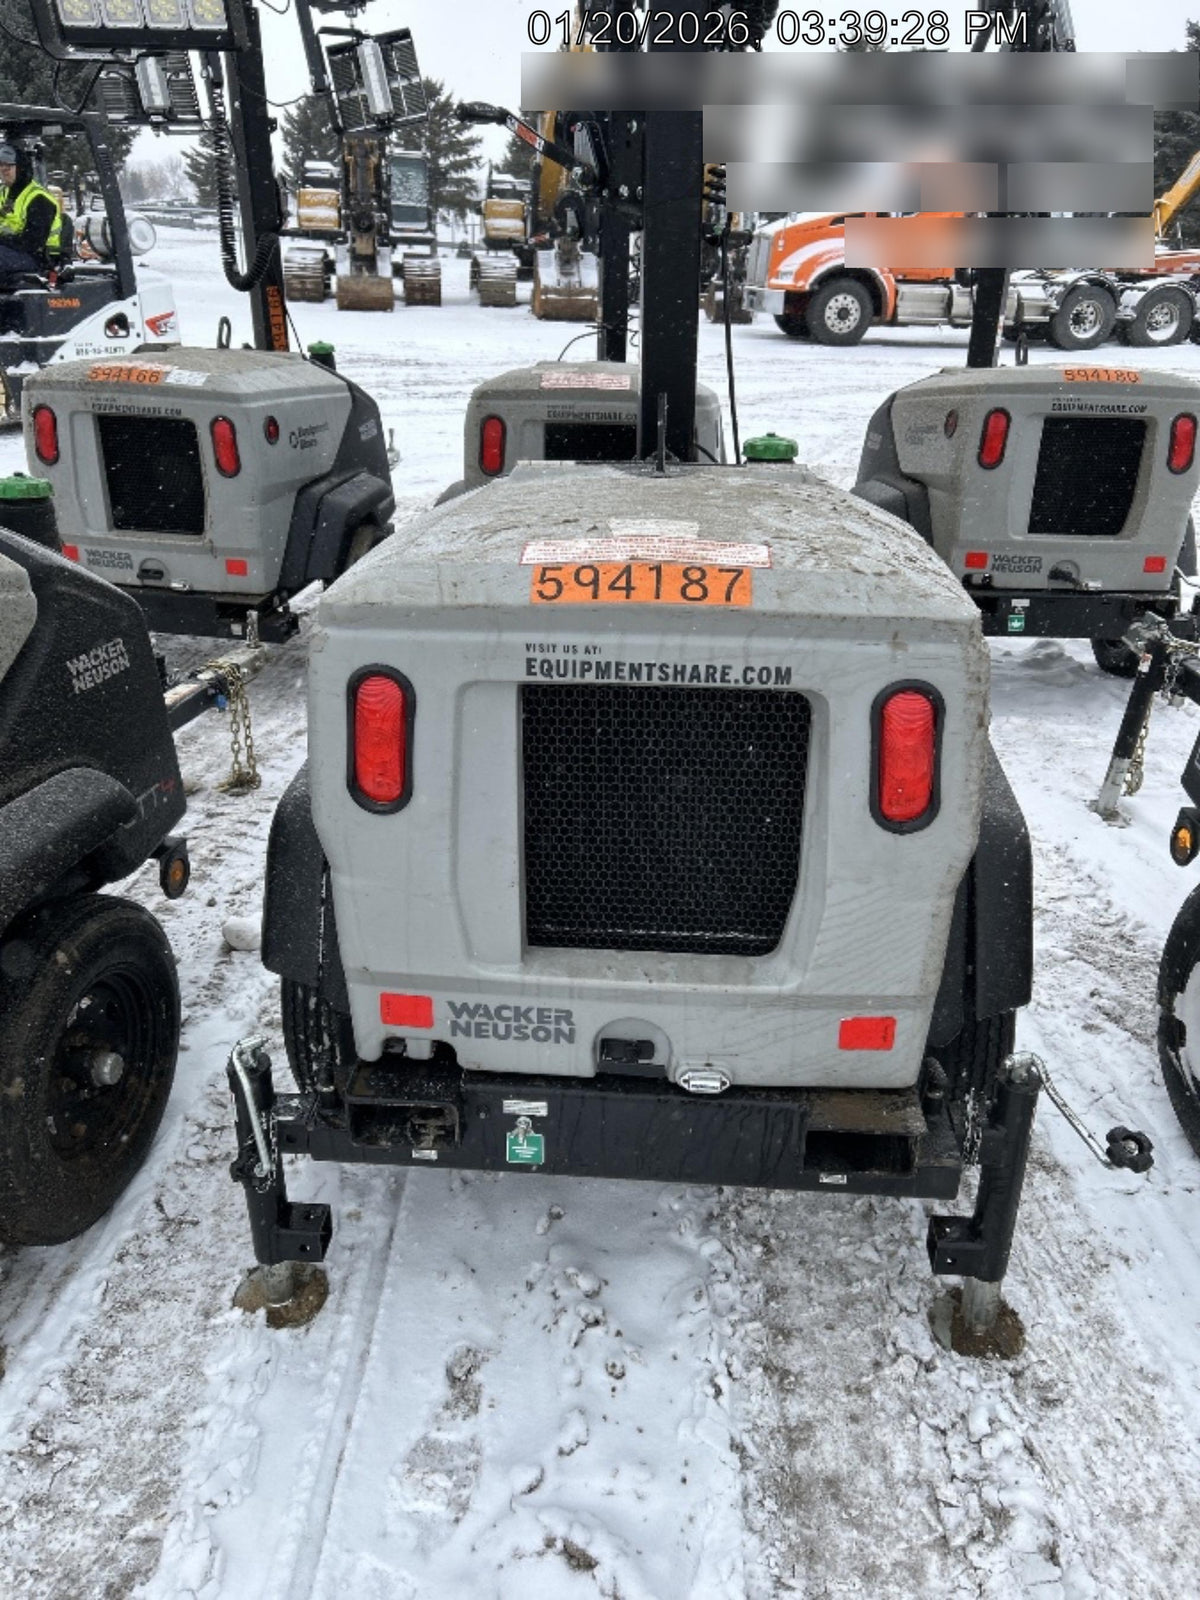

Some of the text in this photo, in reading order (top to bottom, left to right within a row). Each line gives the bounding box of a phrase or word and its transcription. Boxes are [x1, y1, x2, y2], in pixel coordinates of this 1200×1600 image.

[88, 365, 161, 383] 594166
[1064, 369, 1139, 383] 594180
[84, 549, 132, 561] WACKER
[87, 558, 133, 570] NEUSON
[991, 554, 1043, 568] WACKER
[990, 563, 1043, 574] NEUSON
[536, 564, 744, 603] 594187
[66, 638, 128, 676] WACKER
[525, 643, 557, 654] VISIT
[563, 645, 578, 655] US
[72, 656, 130, 694] NEUSON
[525, 657, 792, 686] EQUIPMENTSHARE.COM
[446, 1001, 576, 1026] WACKER
[451, 1020, 576, 1045] NEUSON
